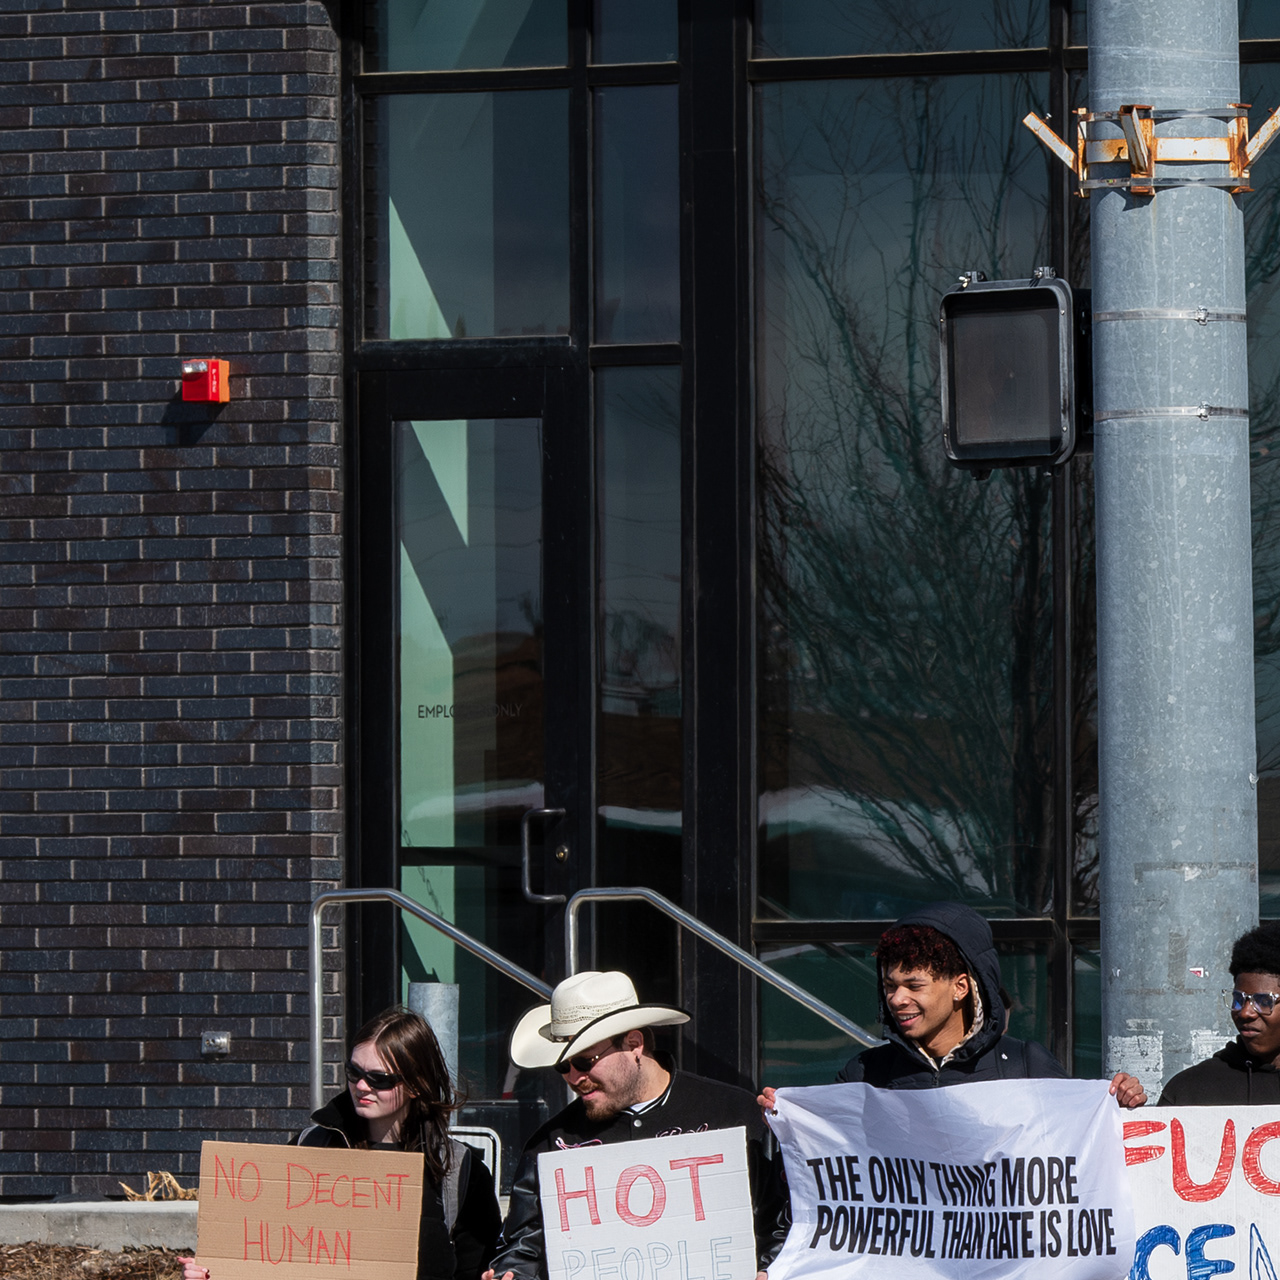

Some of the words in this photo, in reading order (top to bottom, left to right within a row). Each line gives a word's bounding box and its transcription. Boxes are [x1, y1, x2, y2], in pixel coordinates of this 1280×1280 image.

[214, 1154, 262, 1202] NO
[286, 1162, 410, 1211] DECENT
[555, 1153, 724, 1232] HOT
[806, 1155, 864, 1202] THE
[868, 1155, 928, 1206] ONLY
[929, 1161, 997, 1207] THING
[1001, 1156, 1079, 1206] MORE
[243, 1216, 352, 1271] HUMAN
[809, 1204, 936, 1259] POWERFUL
[940, 1209, 986, 1260] THAN
[986, 1209, 1034, 1260] HATE
[1040, 1208, 1061, 1258] IS
[1067, 1207, 1117, 1257] LOVE
